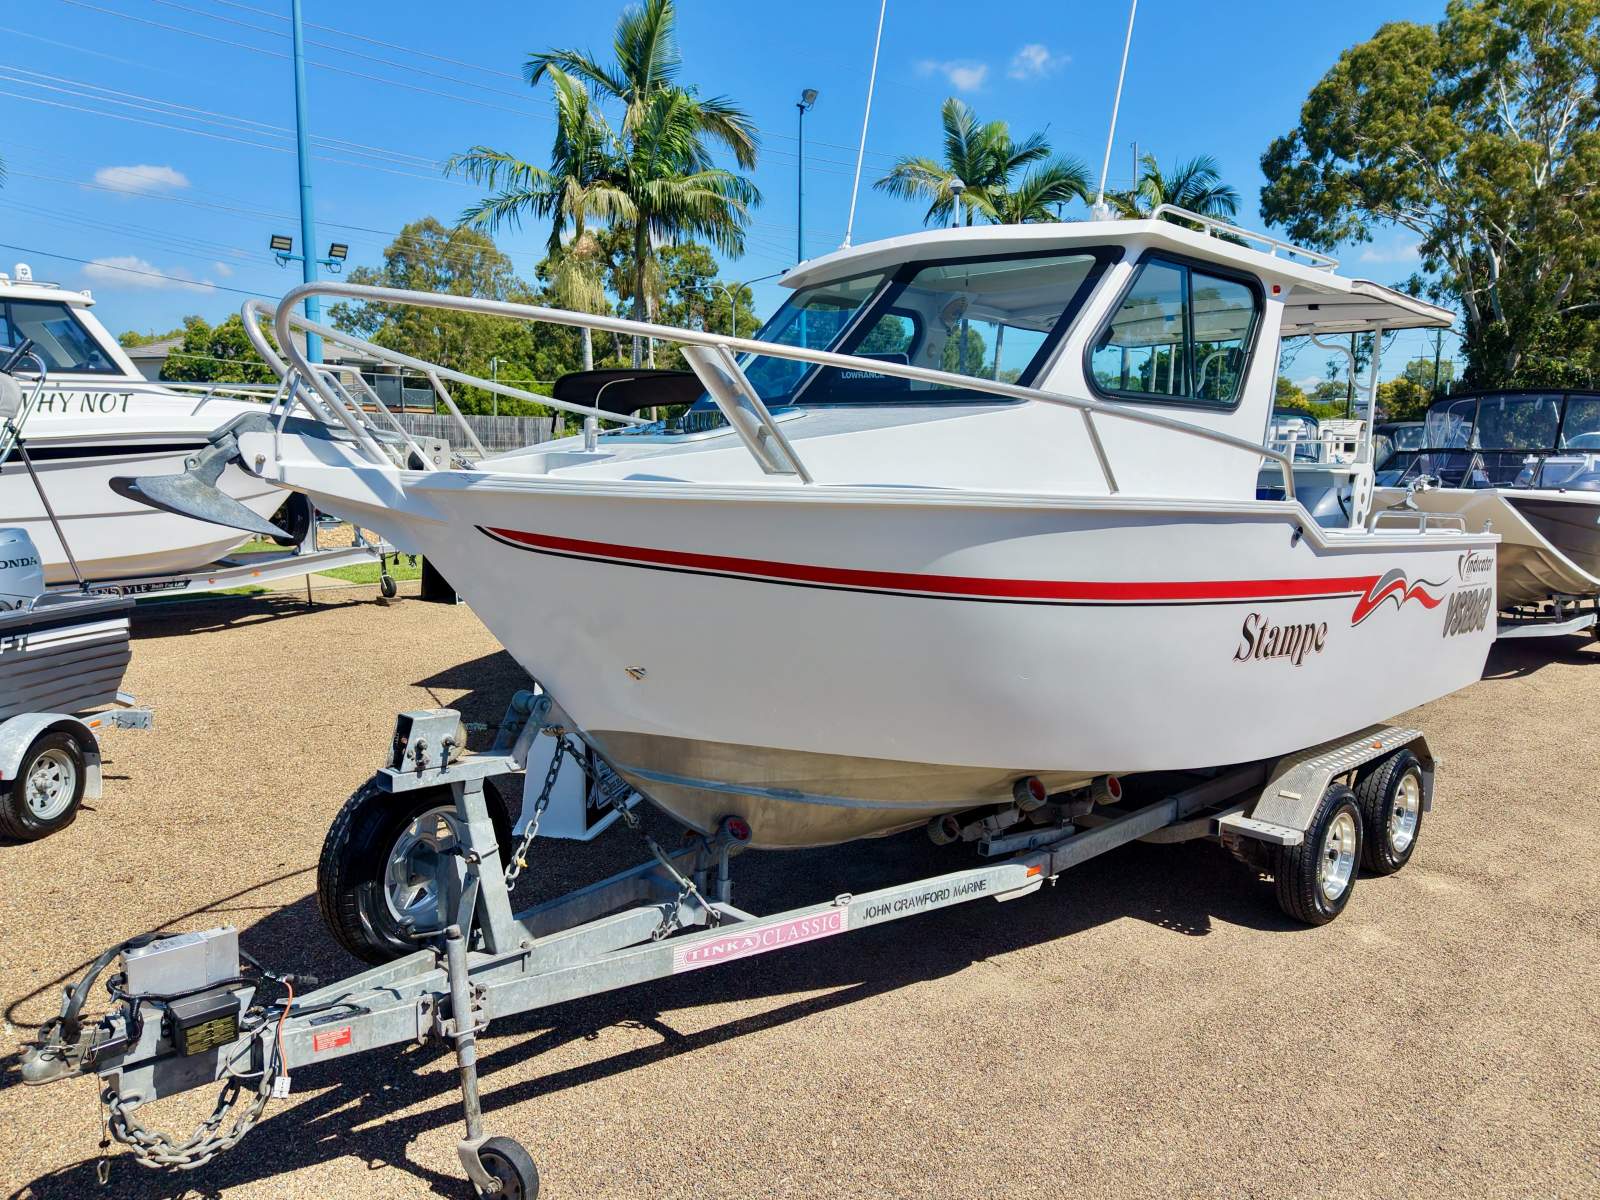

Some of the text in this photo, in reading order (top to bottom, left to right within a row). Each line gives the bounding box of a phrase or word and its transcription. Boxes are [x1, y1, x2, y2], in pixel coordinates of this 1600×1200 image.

[80, 393, 134, 413] NOT
[0, 557, 38, 569] ONDA
[1232, 612, 1328, 668] Stampe
[863, 879, 988, 920] JOHN CRAWFORD MARINE
[691, 913, 841, 961] TINKA CLASSIC
